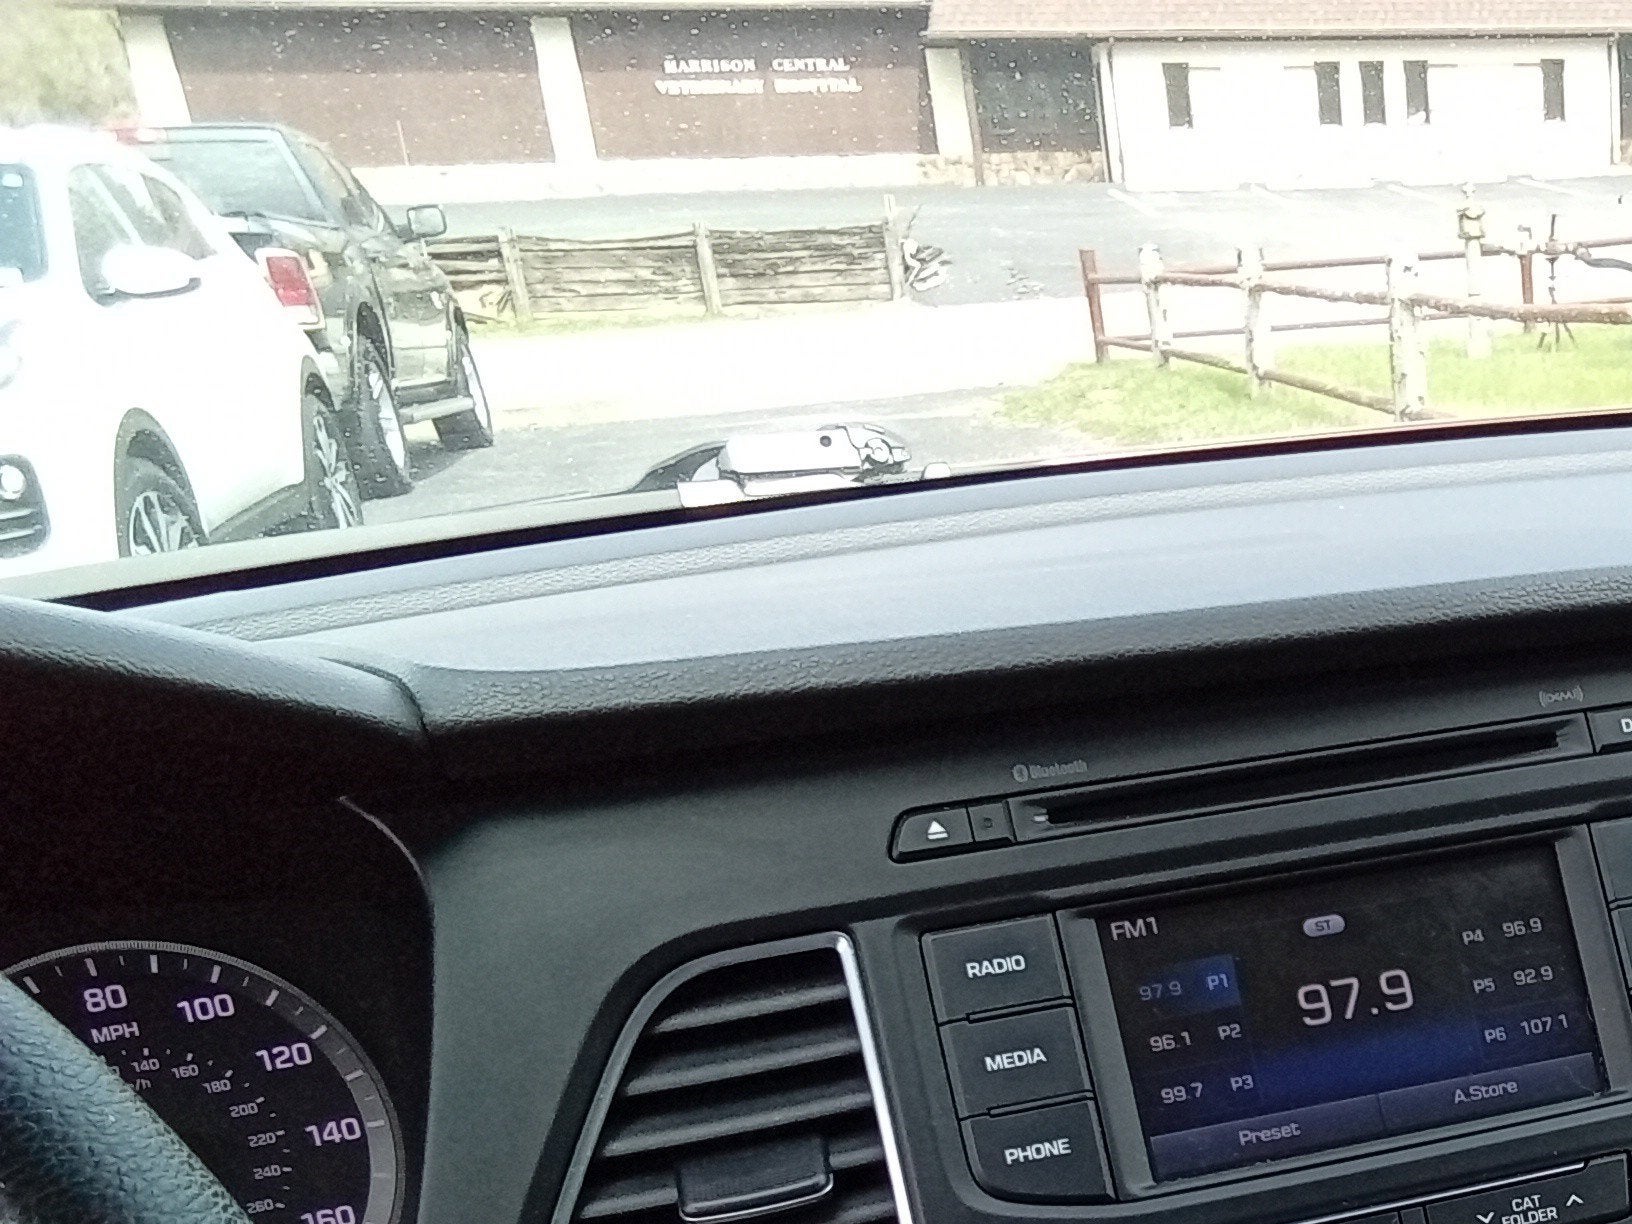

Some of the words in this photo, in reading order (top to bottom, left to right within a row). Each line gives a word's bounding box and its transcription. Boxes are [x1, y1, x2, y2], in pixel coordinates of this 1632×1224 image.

[664, 58, 756, 73] HARRISON
[771, 57, 850, 72] CENTRAL
[1109, 916, 1159, 941] FM1
[1314, 918, 1335, 934] ST
[1462, 928, 1485, 946] P4
[1502, 916, 1543, 938] 96.9
[965, 954, 1027, 979] RADIO
[1139, 979, 1182, 1002] 979
[1205, 972, 1230, 993] P1
[1296, 968, 1415, 1027] 97.9
[1473, 976, 1496, 994] P5
[83, 984, 128, 1013] 80
[176, 993, 236, 1024] 100
[91, 1021, 140, 1044] MPH
[1149, 1030, 1192, 1053] 96.1
[1217, 1023, 1242, 1042] P2
[1484, 1026, 1507, 1044] P6
[1519, 1013, 1569, 1037] 1071
[131, 1058, 160, 1073] 140
[255, 1042, 314, 1072] 120
[984, 1047, 1047, 1072] MEDIA
[171, 1064, 199, 1079] 160
[201, 1079, 231, 1094] 180
[1160, 1082, 1203, 1104] 99.7
[1230, 1074, 1255, 1093] P3
[1453, 1078, 1519, 1106] A.Store
[229, 1102, 259, 1118] 200
[248, 1132, 276, 1148] 220
[305, 1117, 362, 1147] 140
[1238, 1121, 1301, 1147] Preset
[1003, 1138, 1072, 1165] PHONE
[253, 1164, 281, 1180] 240
[246, 1198, 274, 1214] 260
[1511, 1194, 1541, 1212] CAT
